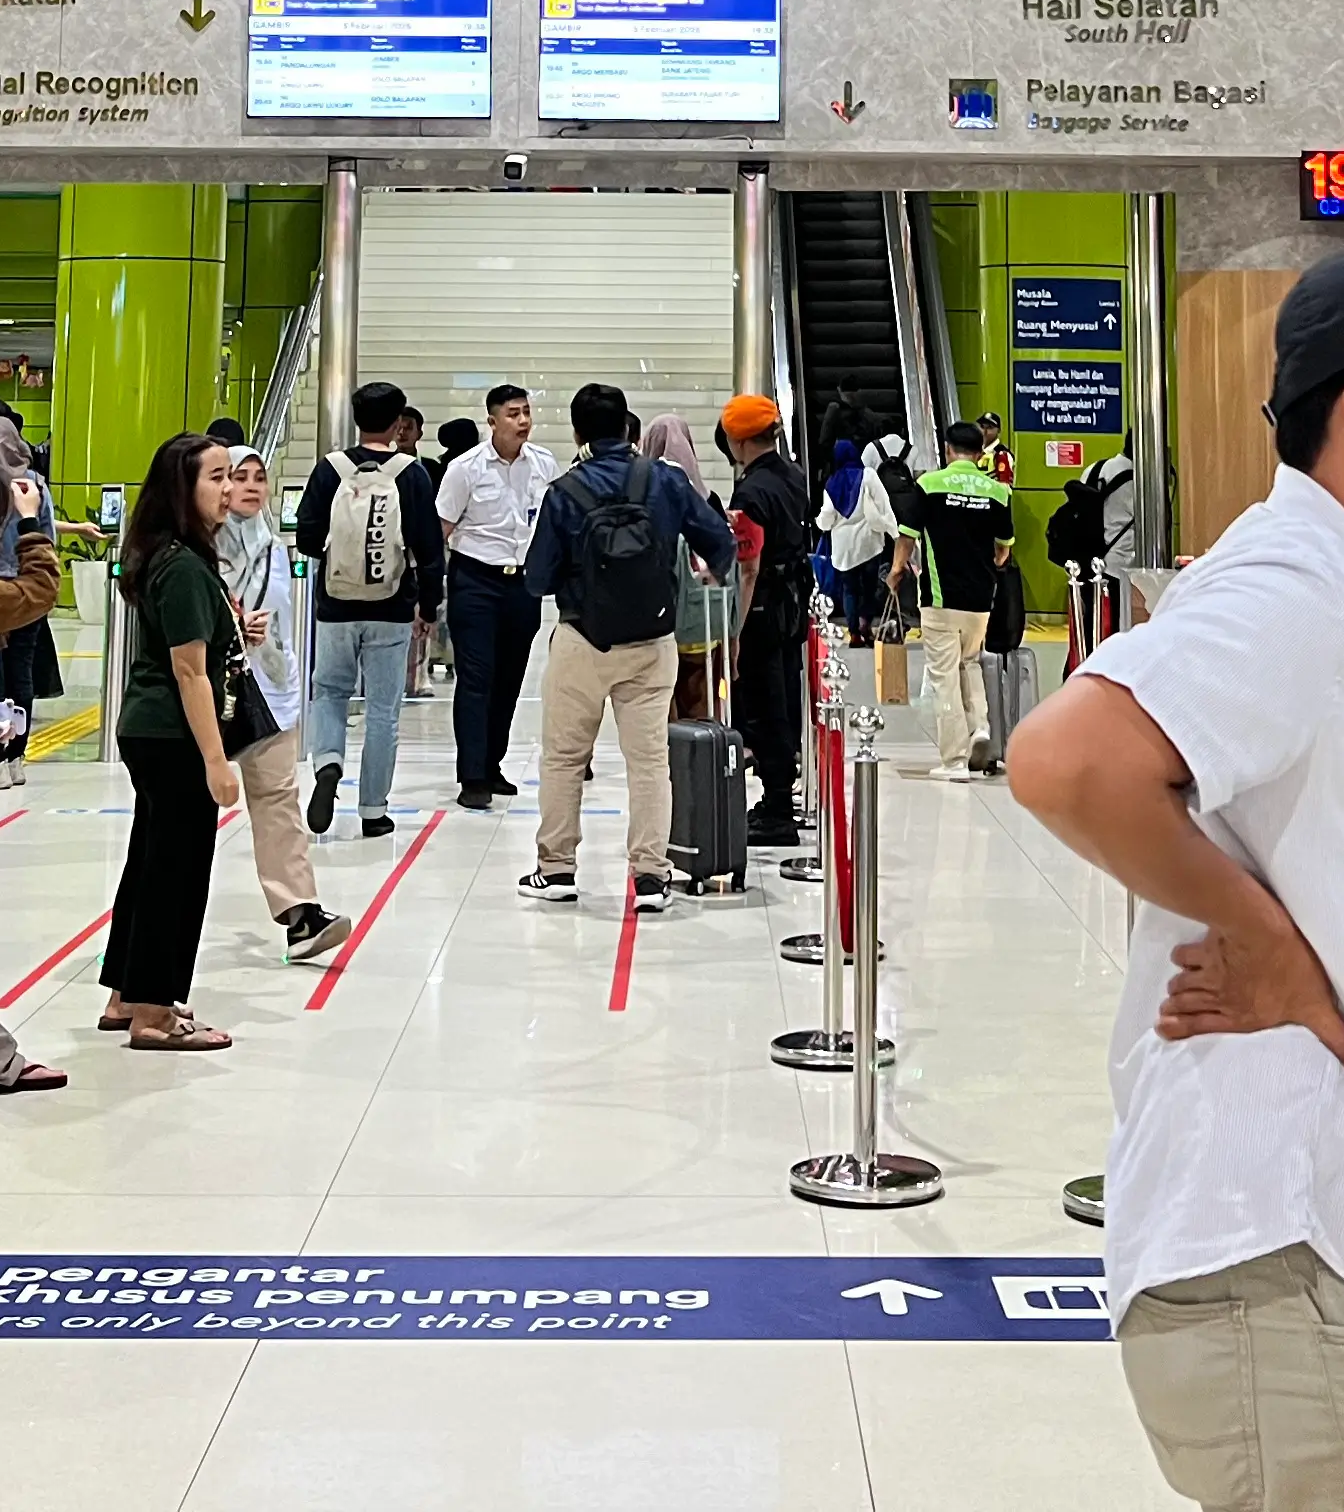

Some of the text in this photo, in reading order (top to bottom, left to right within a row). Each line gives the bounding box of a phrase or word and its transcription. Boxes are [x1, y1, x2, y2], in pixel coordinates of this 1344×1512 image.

[1064, 18, 1192, 44] South Hall
[36, 71, 198, 101] Recognition
[1026, 79, 1266, 110] Pelayanan Bagasi
[1027, 111, 1189, 133] Baggage Service
[1017, 319, 1047, 332] Ruang
[1070, 369, 1090, 380] Hamil
[1092, 370, 1104, 380] dan
[1030, 399, 1045, 411] agar
[1093, 398, 1106, 410] LIFT
[1056, 412, 1072, 423] arah
[1073, 413, 1092, 424] utara
[942, 473, 993, 492] PORTER
[367, 495, 387, 579] adidas
[253, 1287, 709, 1309] penumpang
[59, 1312, 183, 1332] only
[192, 1312, 402, 1332] beyond
[416, 1312, 515, 1330] this
[527, 1313, 672, 1332] point
